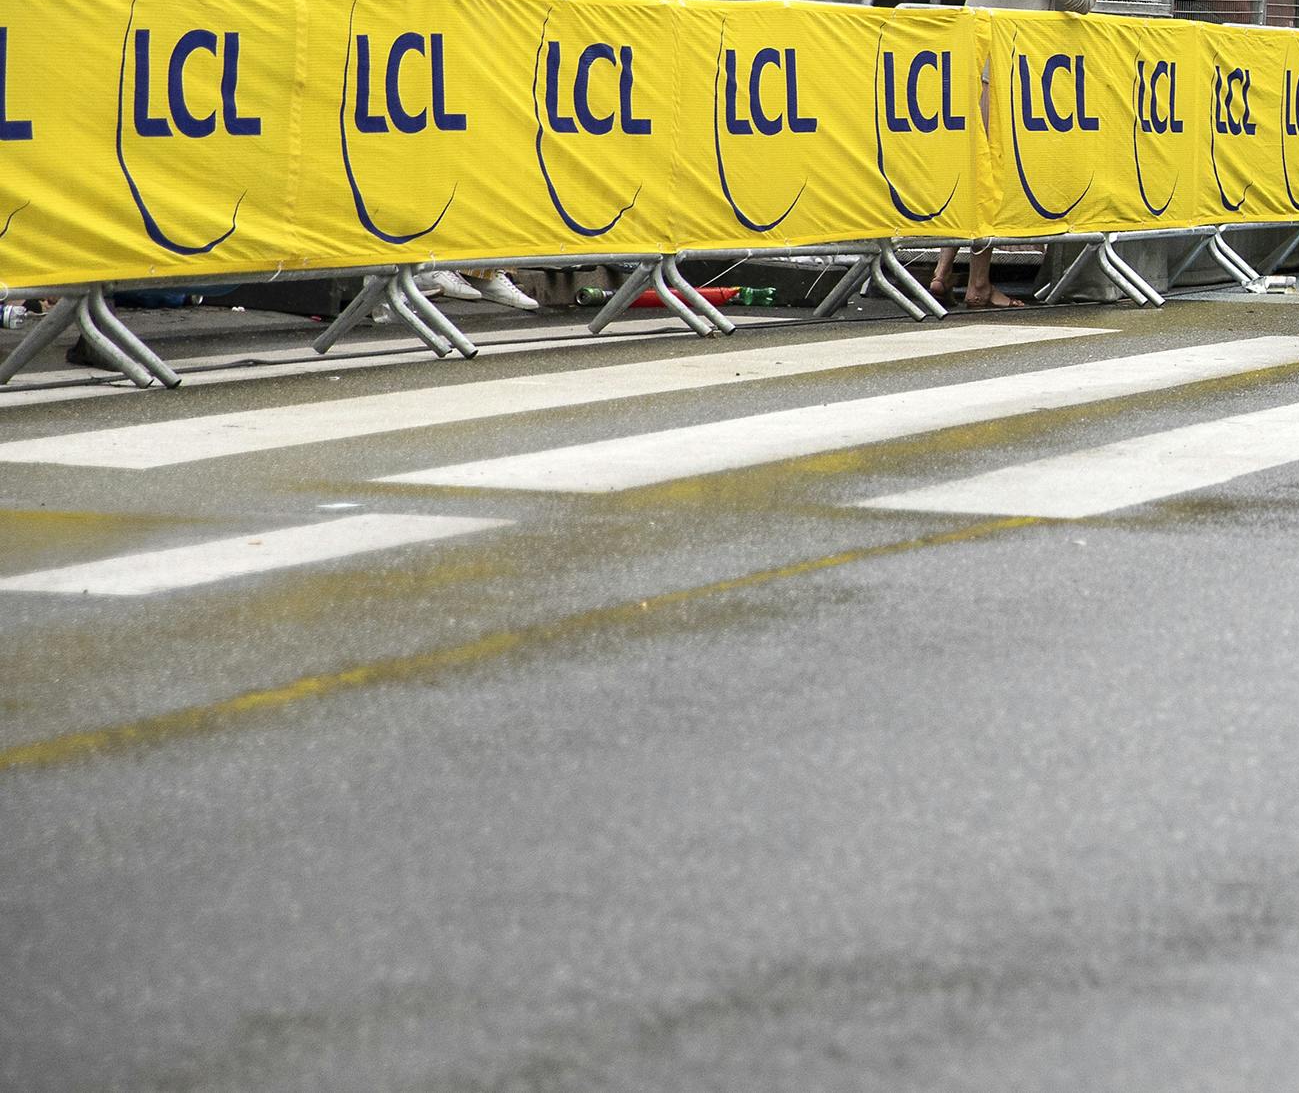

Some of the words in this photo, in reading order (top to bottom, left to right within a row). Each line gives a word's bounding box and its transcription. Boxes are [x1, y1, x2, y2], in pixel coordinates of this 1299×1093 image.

[134, 28, 262, 139] LCL
[355, 32, 468, 134] LCL
[546, 41, 653, 136] LCL
[725, 48, 818, 137] LCL
[883, 50, 966, 133] LCL
[1018, 54, 1100, 132] LCL
[1137, 60, 1184, 134] LCL
[1215, 65, 1257, 136] LCL
